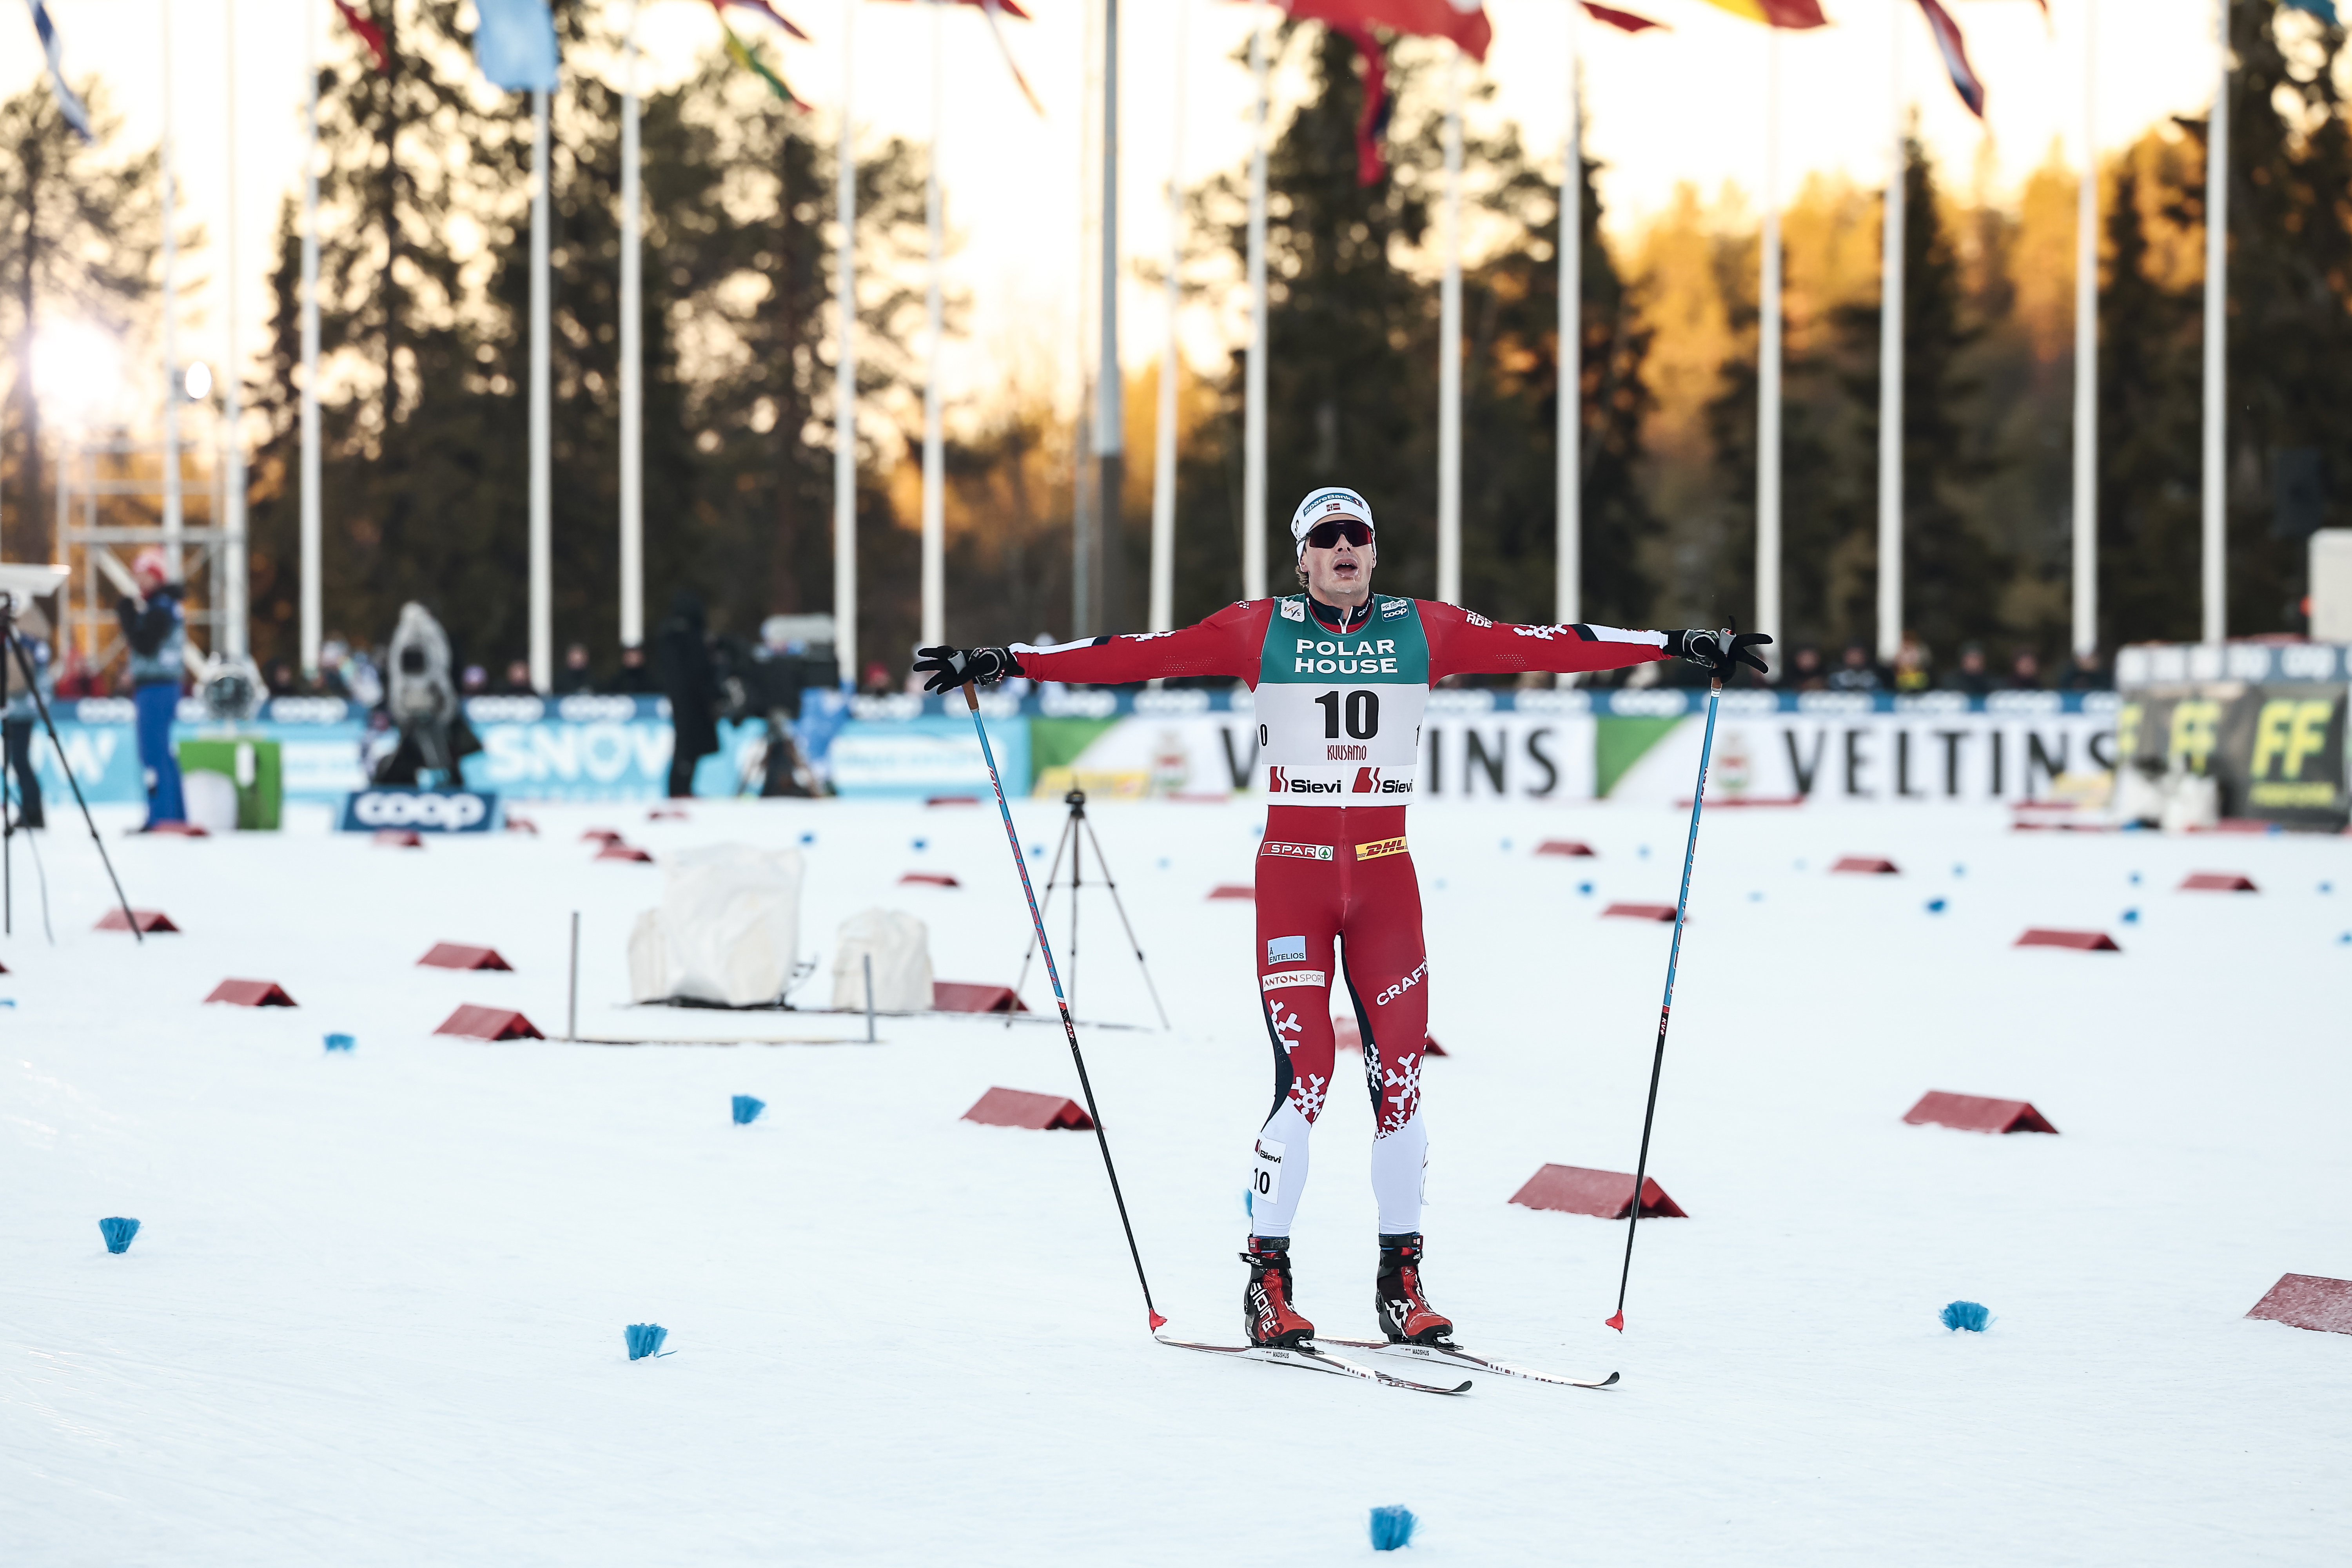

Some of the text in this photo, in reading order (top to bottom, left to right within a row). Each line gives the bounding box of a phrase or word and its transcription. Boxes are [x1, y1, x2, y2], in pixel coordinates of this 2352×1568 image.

[1304, 494, 1352, 514] SpareBank
[1383, 608, 1407, 618] coop
[1296, 639, 1396, 656] POLAR
[1294, 657, 1398, 674] HOUSE
[1314, 690, 1379, 740] 10
[2250, 698, 2333, 779] FF
[1327, 745, 1367, 760] KUUSAMO
[1291, 779, 1341, 793] Sievi
[1382, 779, 1413, 793] Sievi
[353, 792, 485, 831] coop
[1270, 844, 1315, 856] SPAR
[1366, 839, 1404, 857] DHL
[1269, 953, 1304, 963] ENTELIOS
[1264, 974, 1324, 987] ANTON SPORT
[1376, 961, 1427, 1006] CRAFT
[1259, 1149, 1281, 1163] Sievi
[1254, 1167, 1270, 1194] 10
